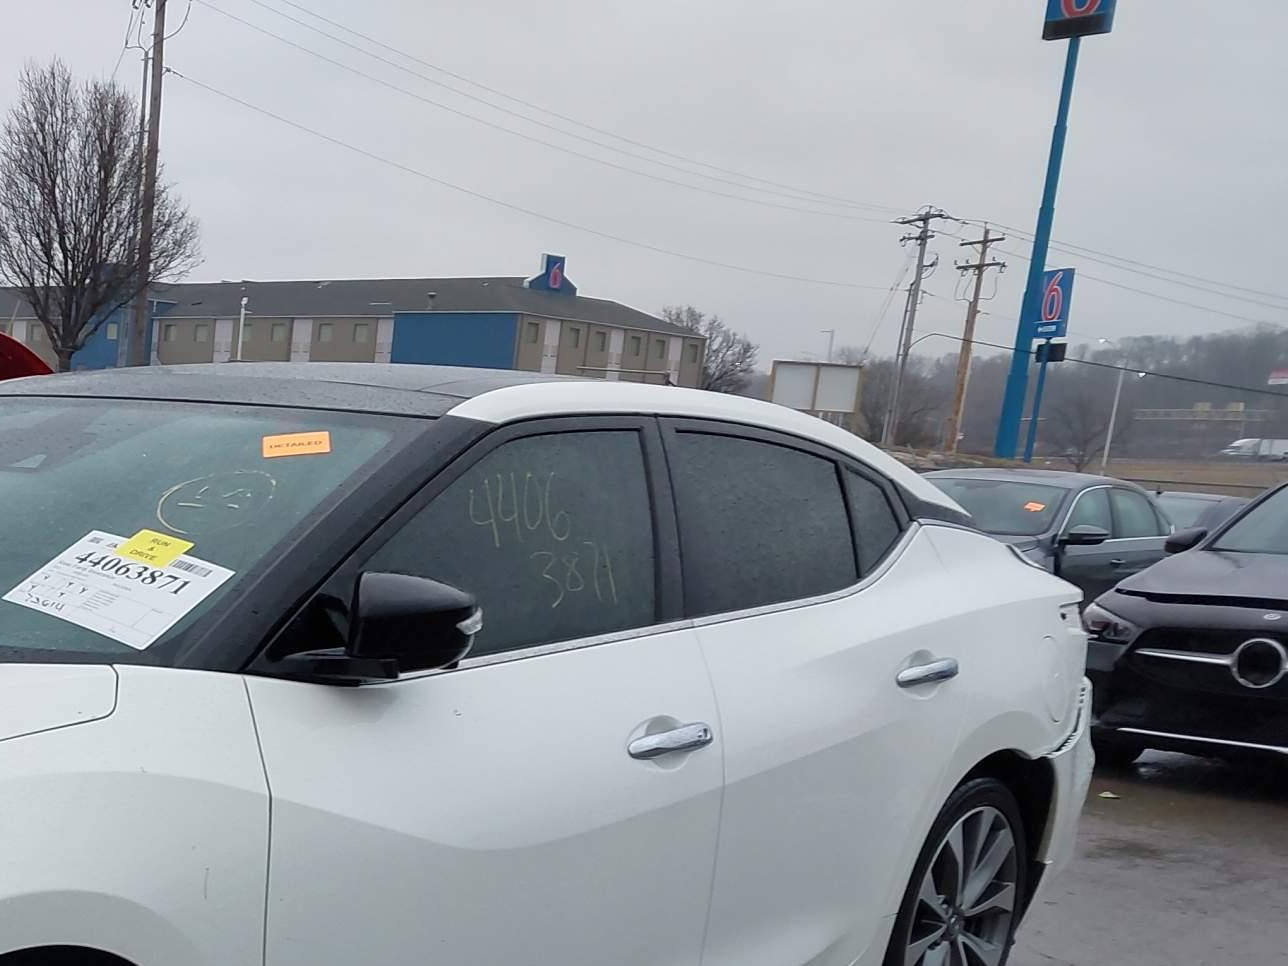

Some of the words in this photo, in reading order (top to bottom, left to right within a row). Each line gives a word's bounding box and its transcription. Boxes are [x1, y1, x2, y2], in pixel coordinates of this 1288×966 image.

[1041, 271, 1063, 322] 6
[469, 471, 570, 547] 4406
[128, 549, 159, 561] DRIVE
[150, 538, 172, 547] RUN
[75, 551, 191, 594] 44063871
[529, 541, 617, 608] 3871
